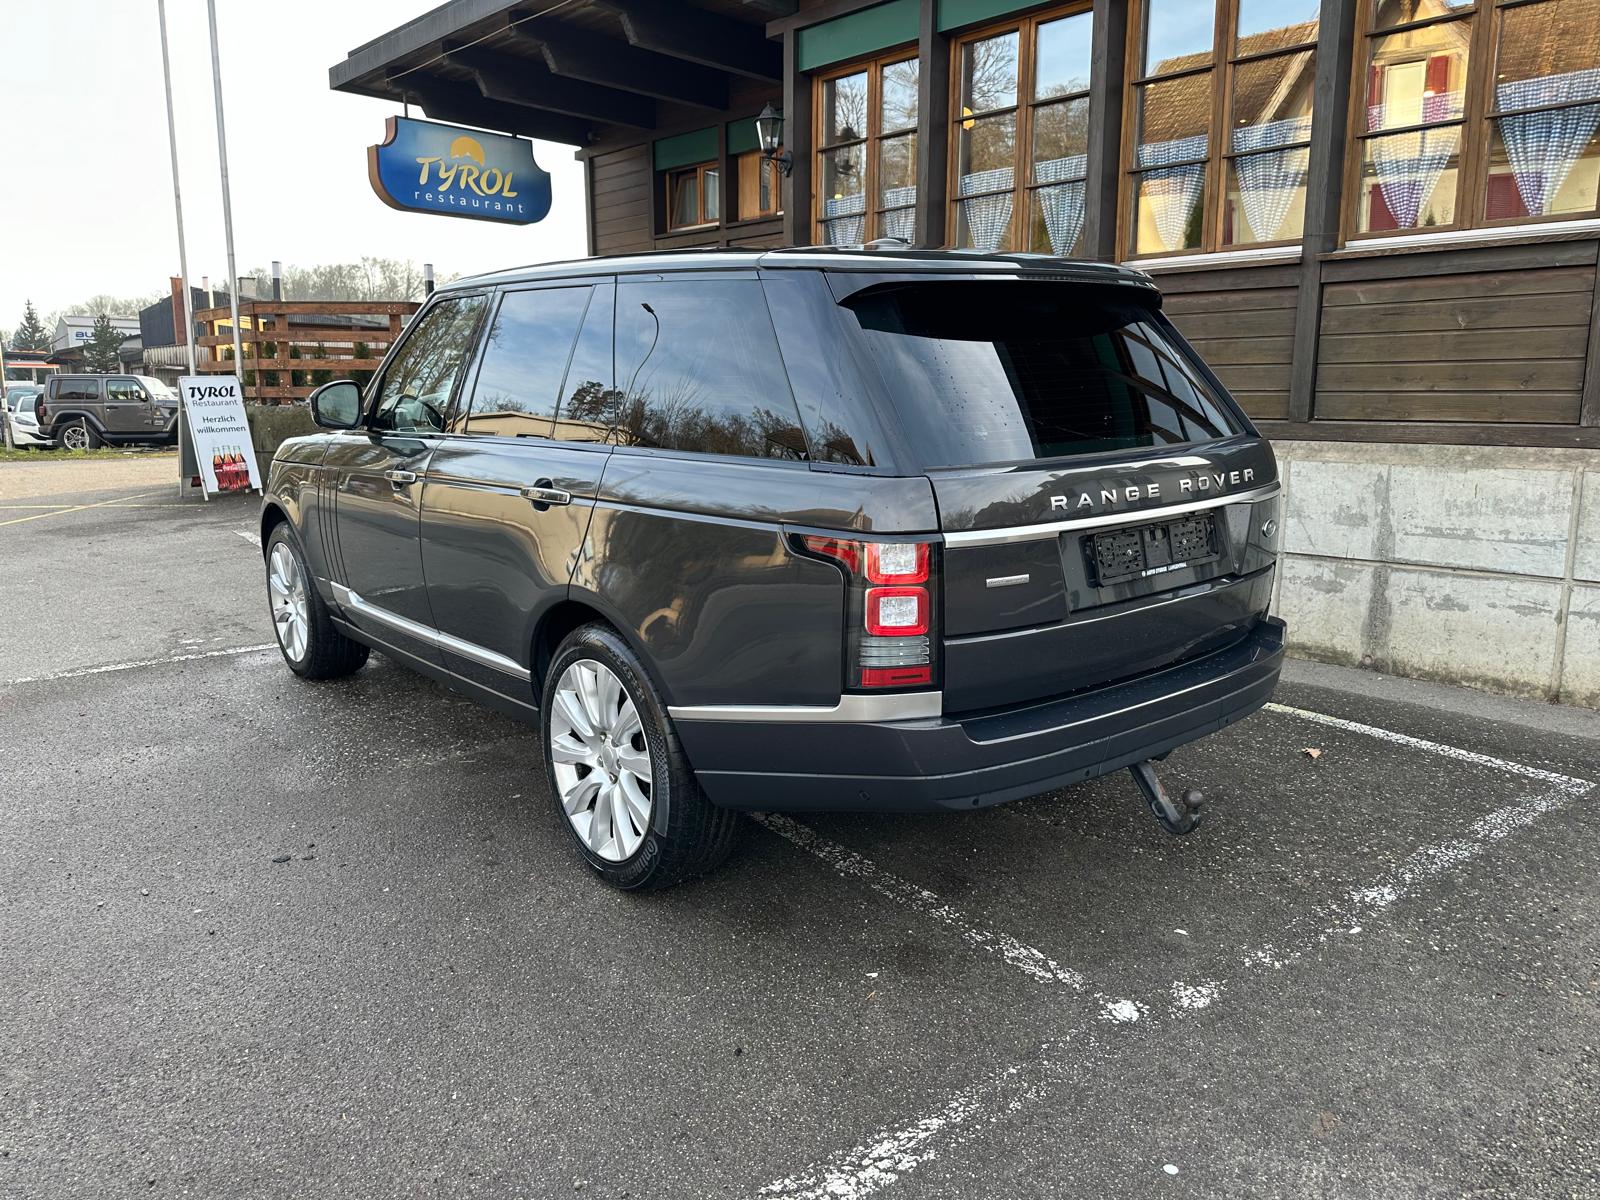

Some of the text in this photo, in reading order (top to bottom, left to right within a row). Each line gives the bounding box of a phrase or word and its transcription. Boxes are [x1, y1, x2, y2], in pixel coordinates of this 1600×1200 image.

[415, 156, 518, 198] TYROL
[415, 191, 523, 213] restaurant
[188, 385, 236, 401] TYROL
[192, 399, 238, 407] Restaurant
[202, 415, 236, 423] Herzlich
[196, 425, 246, 434] willkommen
[1050, 468, 1255, 510] RANGE ROVER
